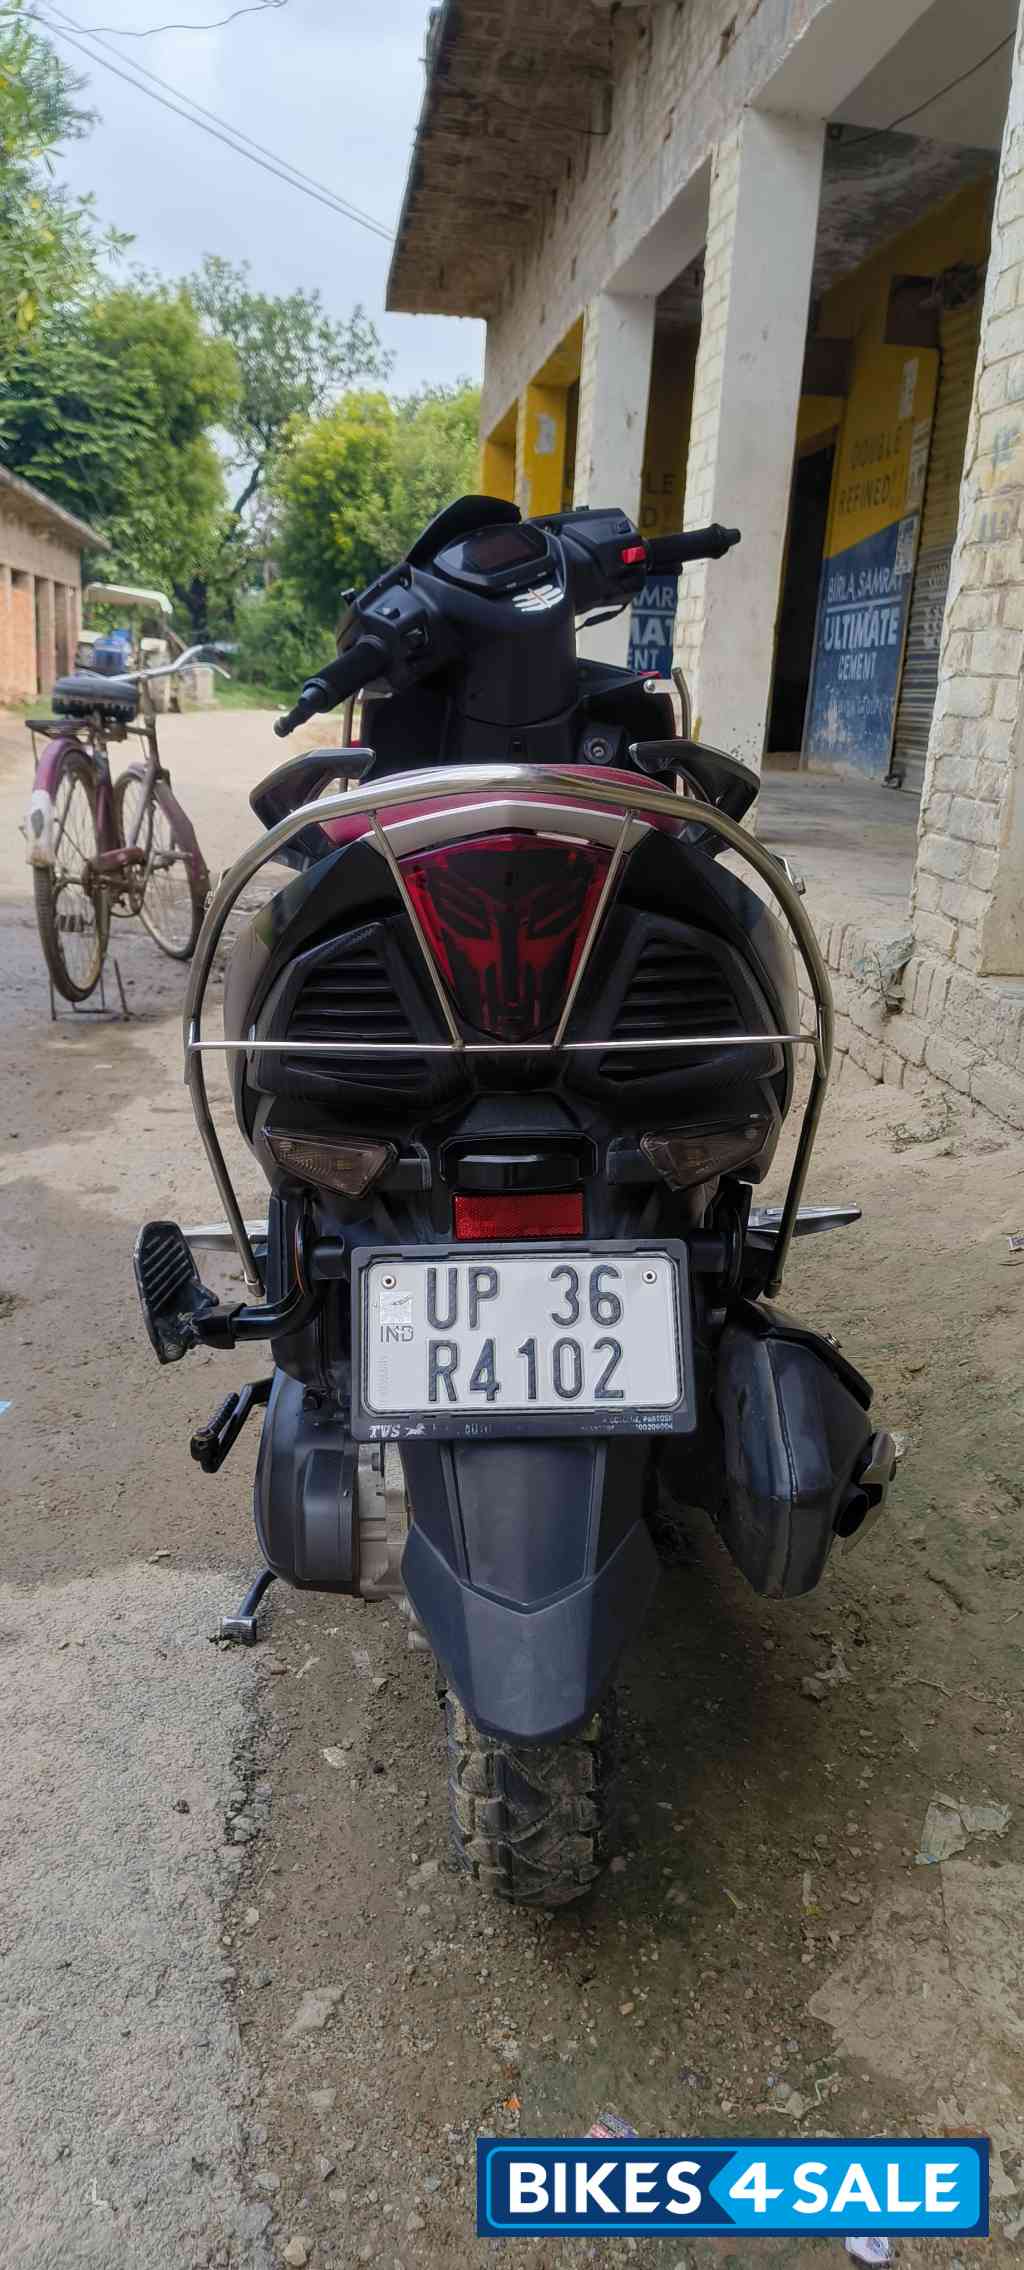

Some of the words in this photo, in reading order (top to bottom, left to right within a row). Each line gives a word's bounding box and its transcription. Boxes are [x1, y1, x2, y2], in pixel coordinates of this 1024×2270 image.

[824, 606, 899, 650] ULTIMATE
[838, 652, 877, 680] CEMENT
[427, 1266, 499, 1329] UP
[550, 1265, 623, 1326] 36
[380, 1325, 414, 1342] IND
[427, 1337, 624, 1402] R4102
[368, 1424, 400, 1438] TVS
